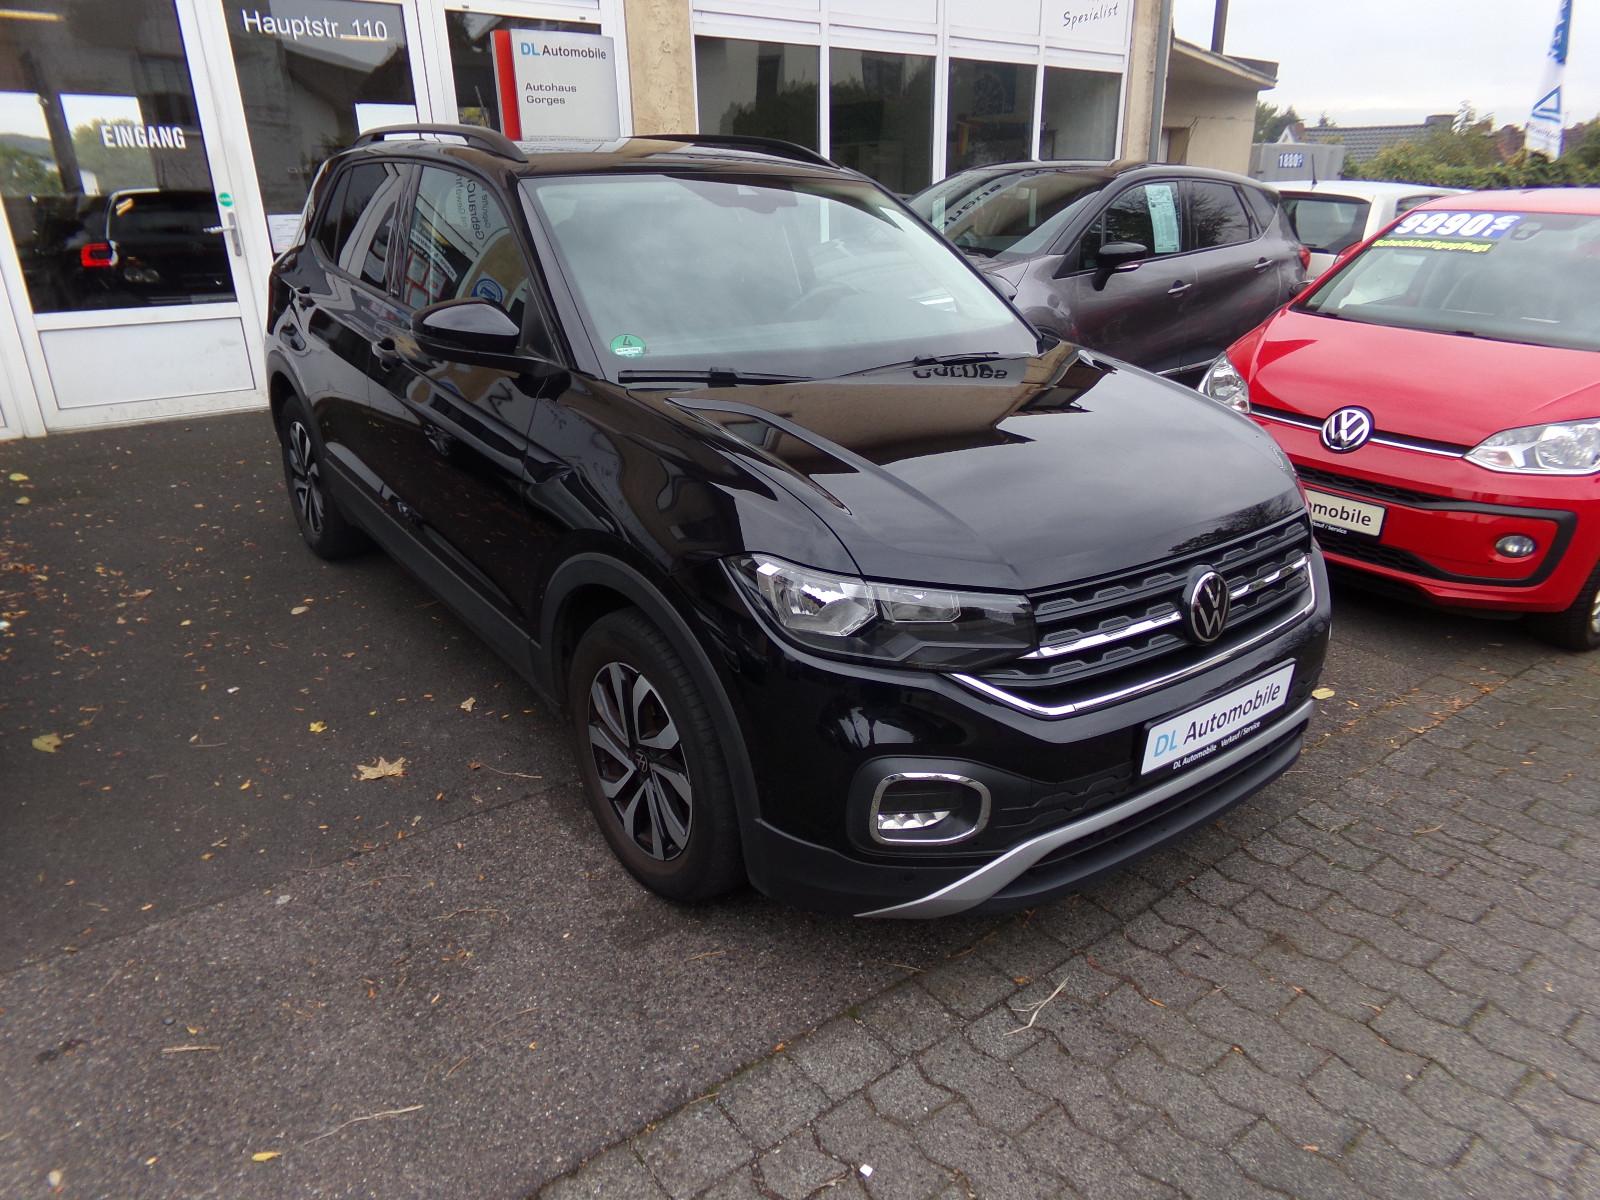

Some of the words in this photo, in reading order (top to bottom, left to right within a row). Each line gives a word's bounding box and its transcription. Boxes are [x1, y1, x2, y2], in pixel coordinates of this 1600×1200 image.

[1063, 2, 1119, 31] Spezialist
[352, 19, 388, 41] 110
[520, 42, 541, 56] DL
[542, 45, 607, 60] Automobile
[525, 82, 577, 93] Autohaus
[526, 95, 566, 106] Gorges
[101, 124, 187, 149] EINGANG
[1153, 730, 1178, 758] DL
[1183, 682, 1281, 745] Automobile
[1172, 761, 1182, 770] DL
[1182, 744, 1217, 766] Automobile
